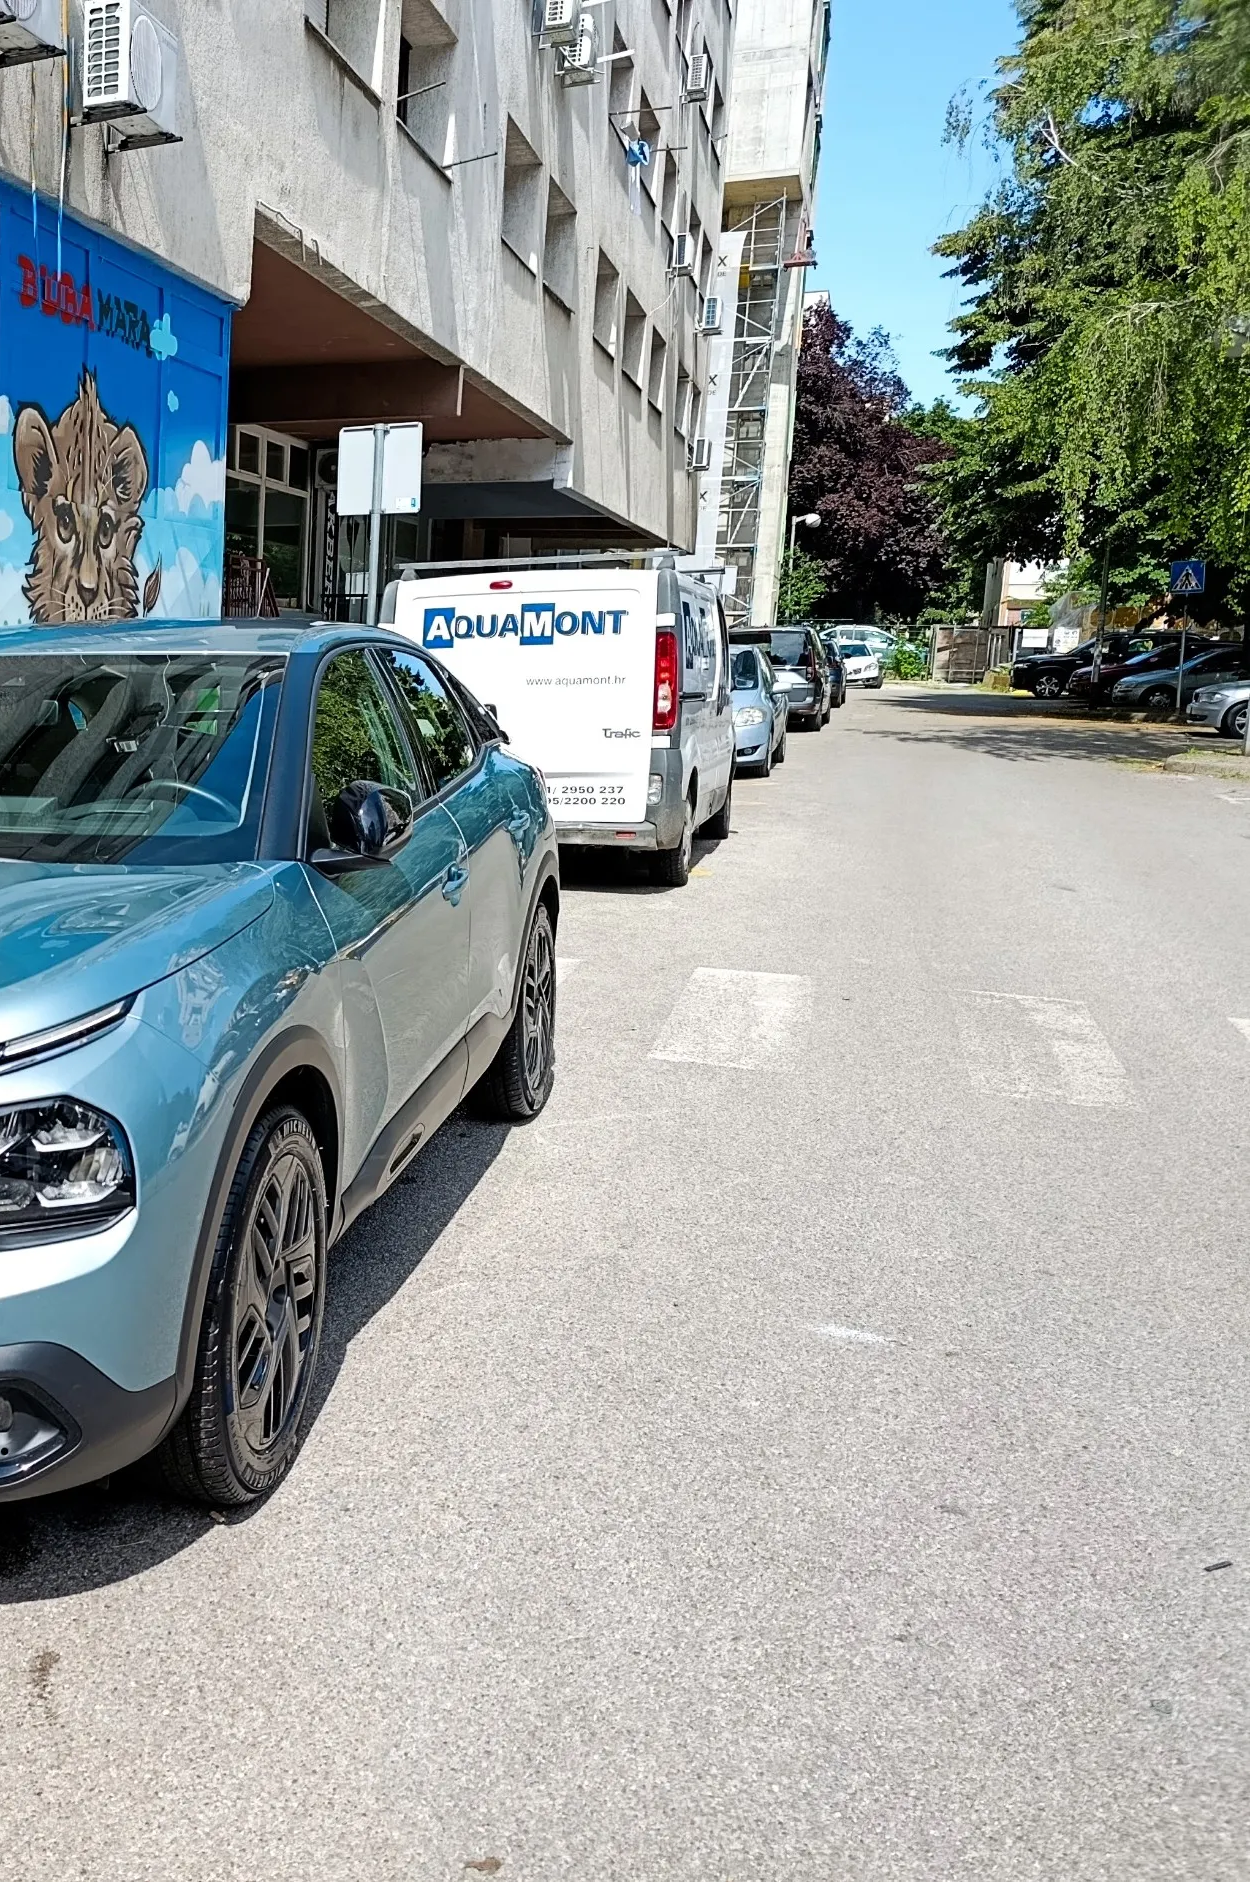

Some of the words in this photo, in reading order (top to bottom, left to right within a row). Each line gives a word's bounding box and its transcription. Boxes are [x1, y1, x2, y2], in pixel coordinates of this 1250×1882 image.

[424, 604, 630, 647] AQUAMONT
[525, 675, 627, 688] www.aquamont.hr
[601, 728, 641, 739] Trafic
[561, 786, 594, 794] 2950
[599, 786, 624, 794] 237
[600, 797, 626, 805] 220
